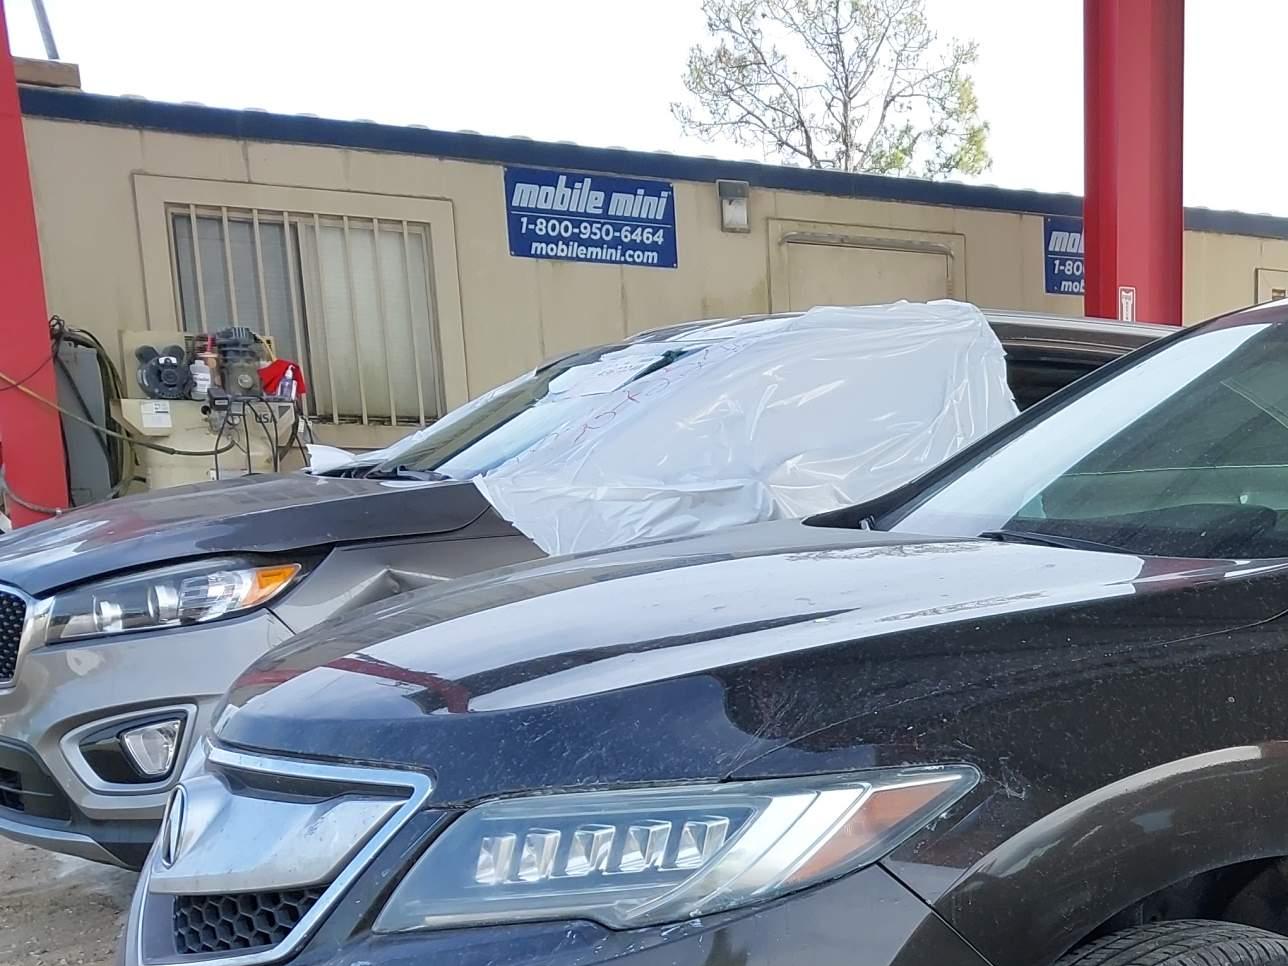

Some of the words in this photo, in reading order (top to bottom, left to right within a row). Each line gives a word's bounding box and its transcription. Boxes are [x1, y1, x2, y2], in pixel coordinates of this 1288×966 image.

[511, 174, 605, 214] mobile
[608, 188, 670, 220] mini
[520, 216, 664, 245] 1-800-950-6464
[530, 240, 658, 264] mobilemini.com
[1054, 260, 1084, 275] 1-80
